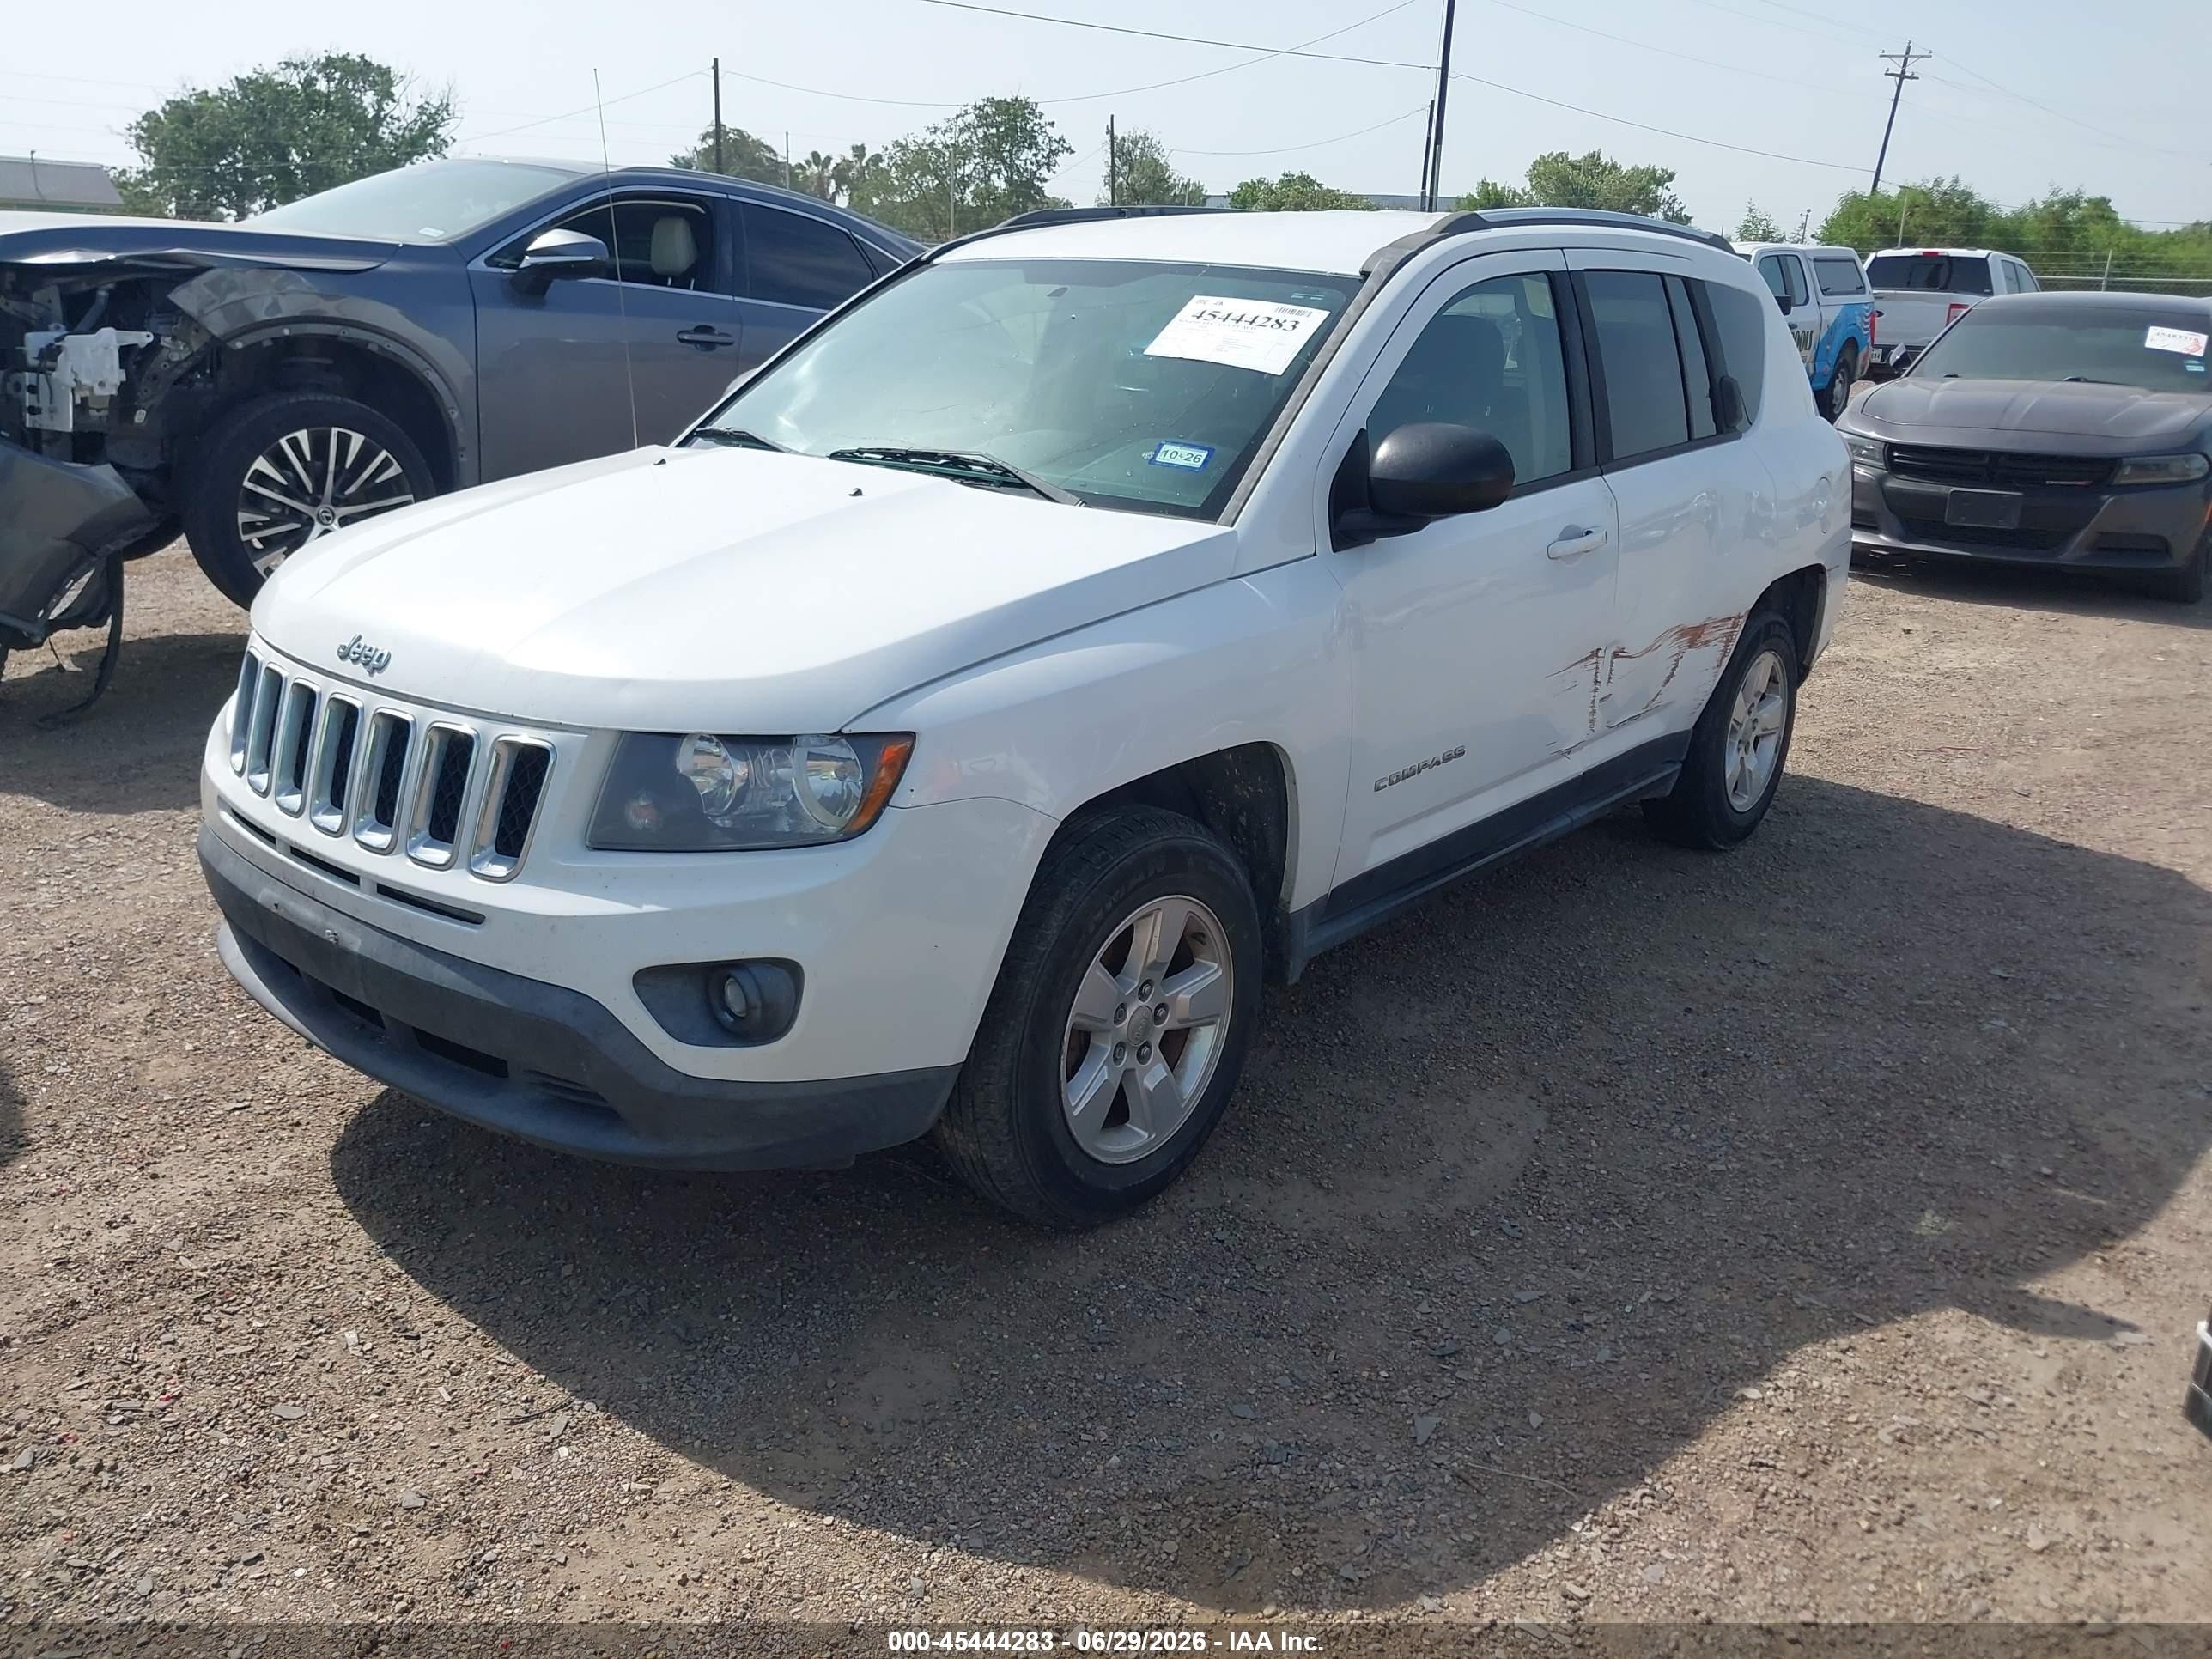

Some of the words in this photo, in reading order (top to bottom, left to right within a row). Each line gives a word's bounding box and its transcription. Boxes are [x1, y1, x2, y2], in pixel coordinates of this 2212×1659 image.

[1191, 309, 1300, 332] 45444283
[337, 632, 392, 675] Jeep
[1373, 744, 1466, 792] COMPASS
